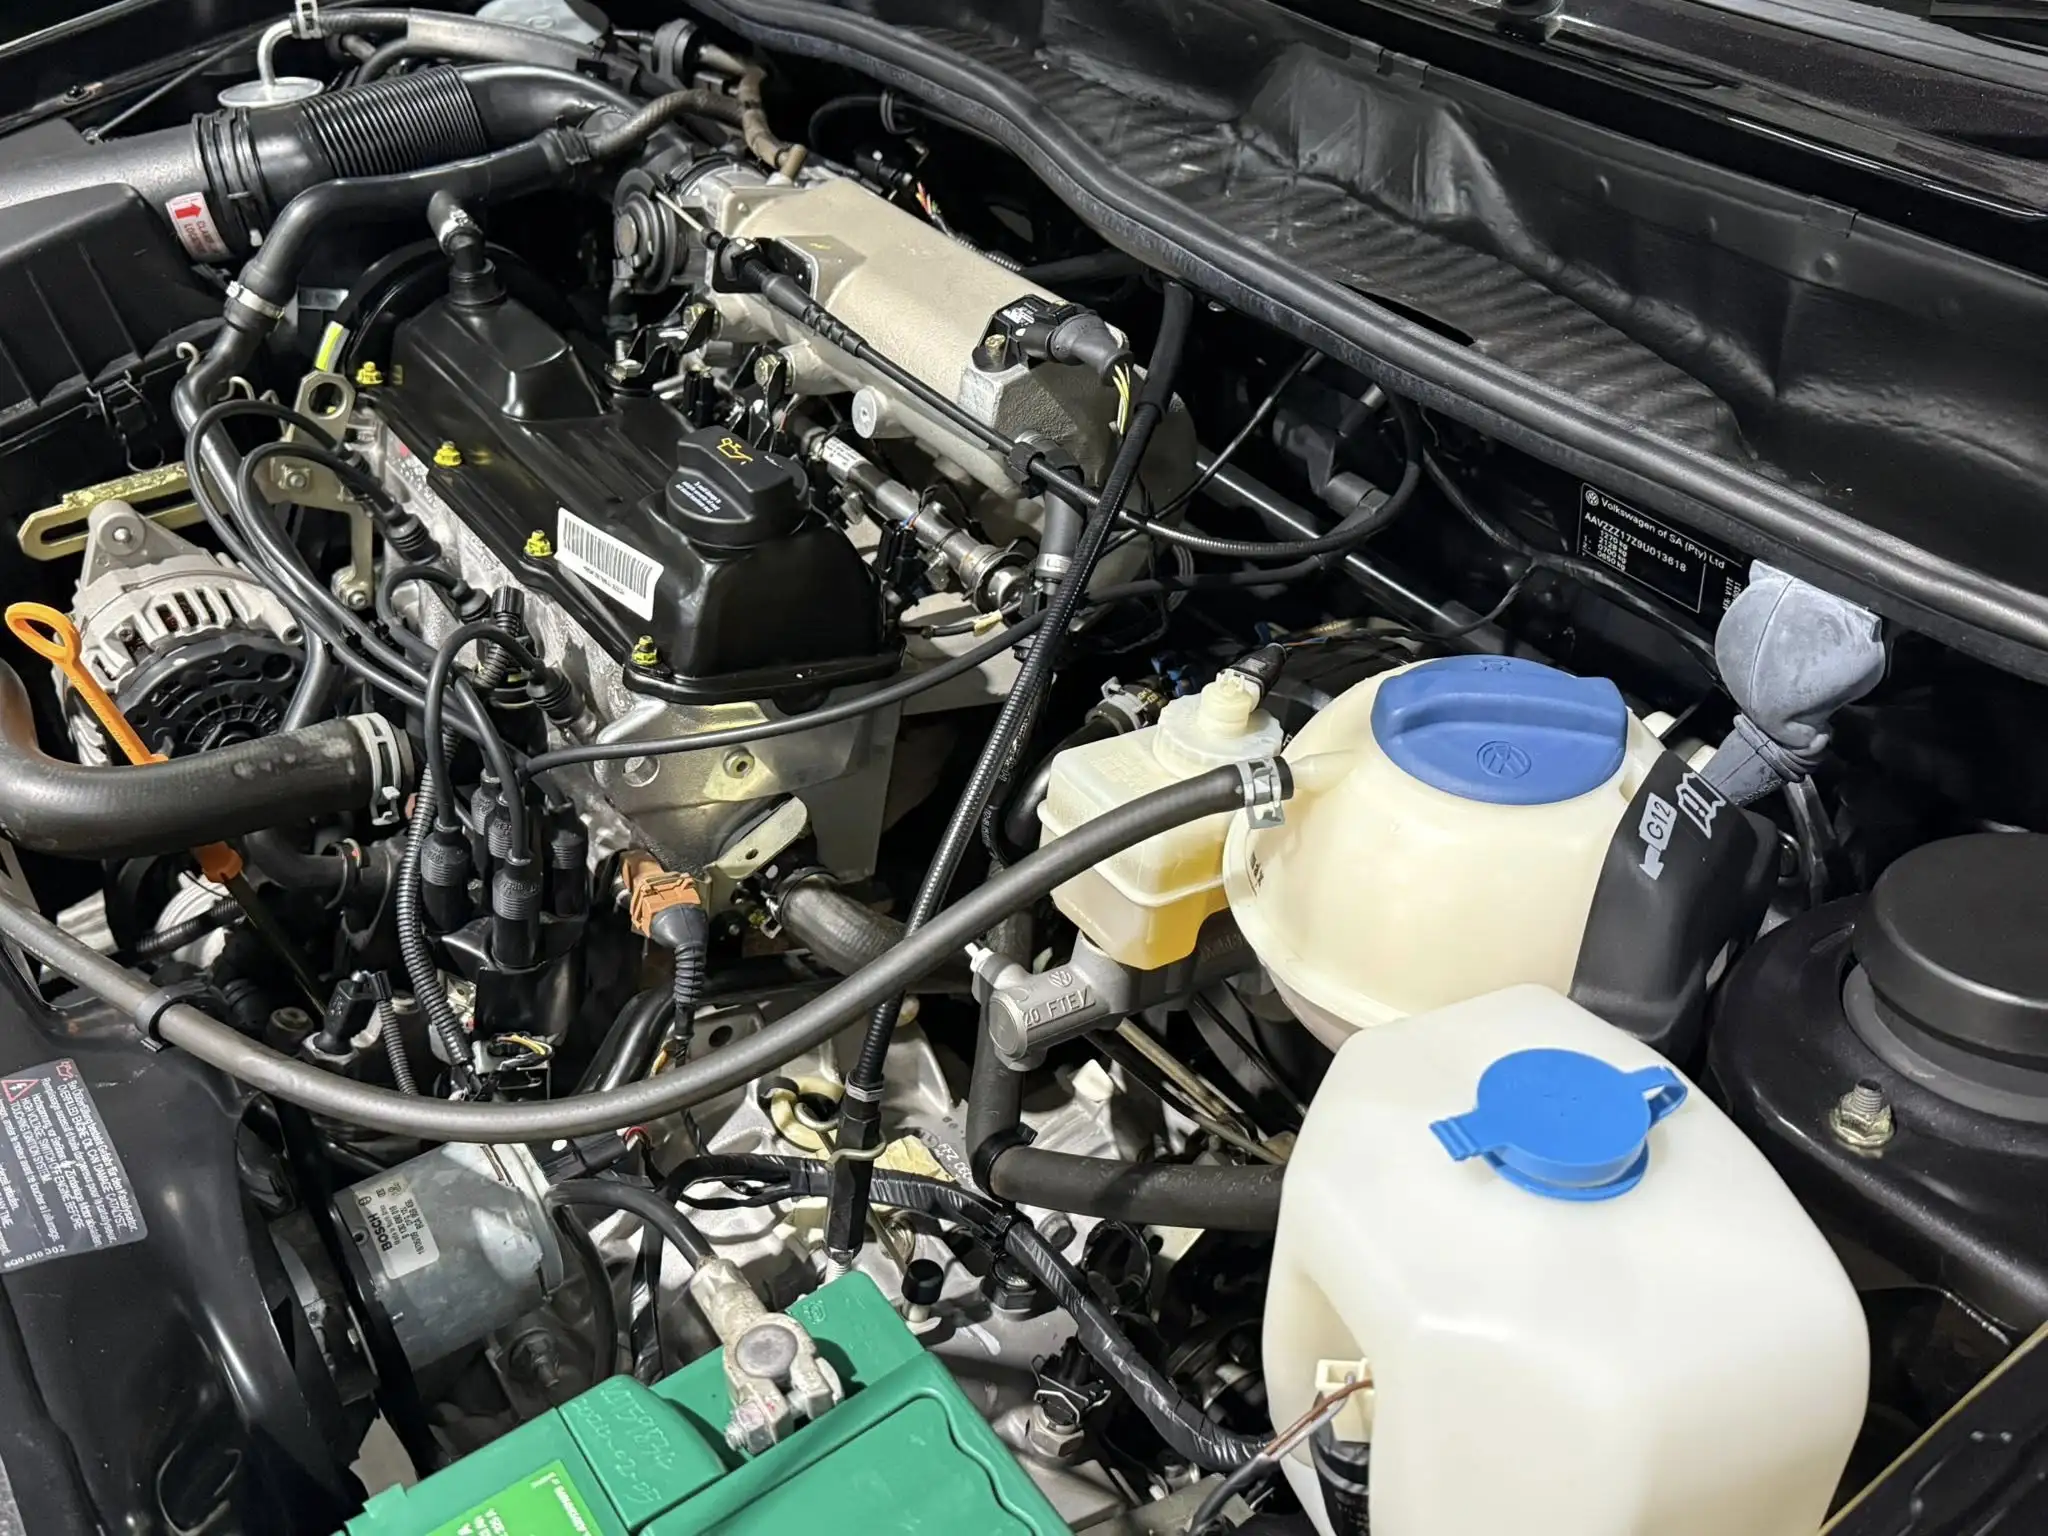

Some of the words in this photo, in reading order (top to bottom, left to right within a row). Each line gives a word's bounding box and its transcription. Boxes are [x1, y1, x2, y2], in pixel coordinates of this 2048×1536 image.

[1602, 497, 1655, 533] Volkswagen
[1658, 528, 1667, 538] of
[1670, 532, 1683, 546] SA
[1685, 541, 1707, 561] (Pty)
[1709, 555, 1725, 569] Ltd
[1618, 547, 1627, 557] kg
[1619, 540, 1628, 550] kg
[1617, 561, 1626, 571] kg
[1618, 554, 1627, 565] kg
[1646, 801, 1671, 840] G12
[87, 1149, 100, 1164] CAN
[93, 1164, 113, 1193] DAMAGE
[368, 1214, 392, 1251] BOSCH
